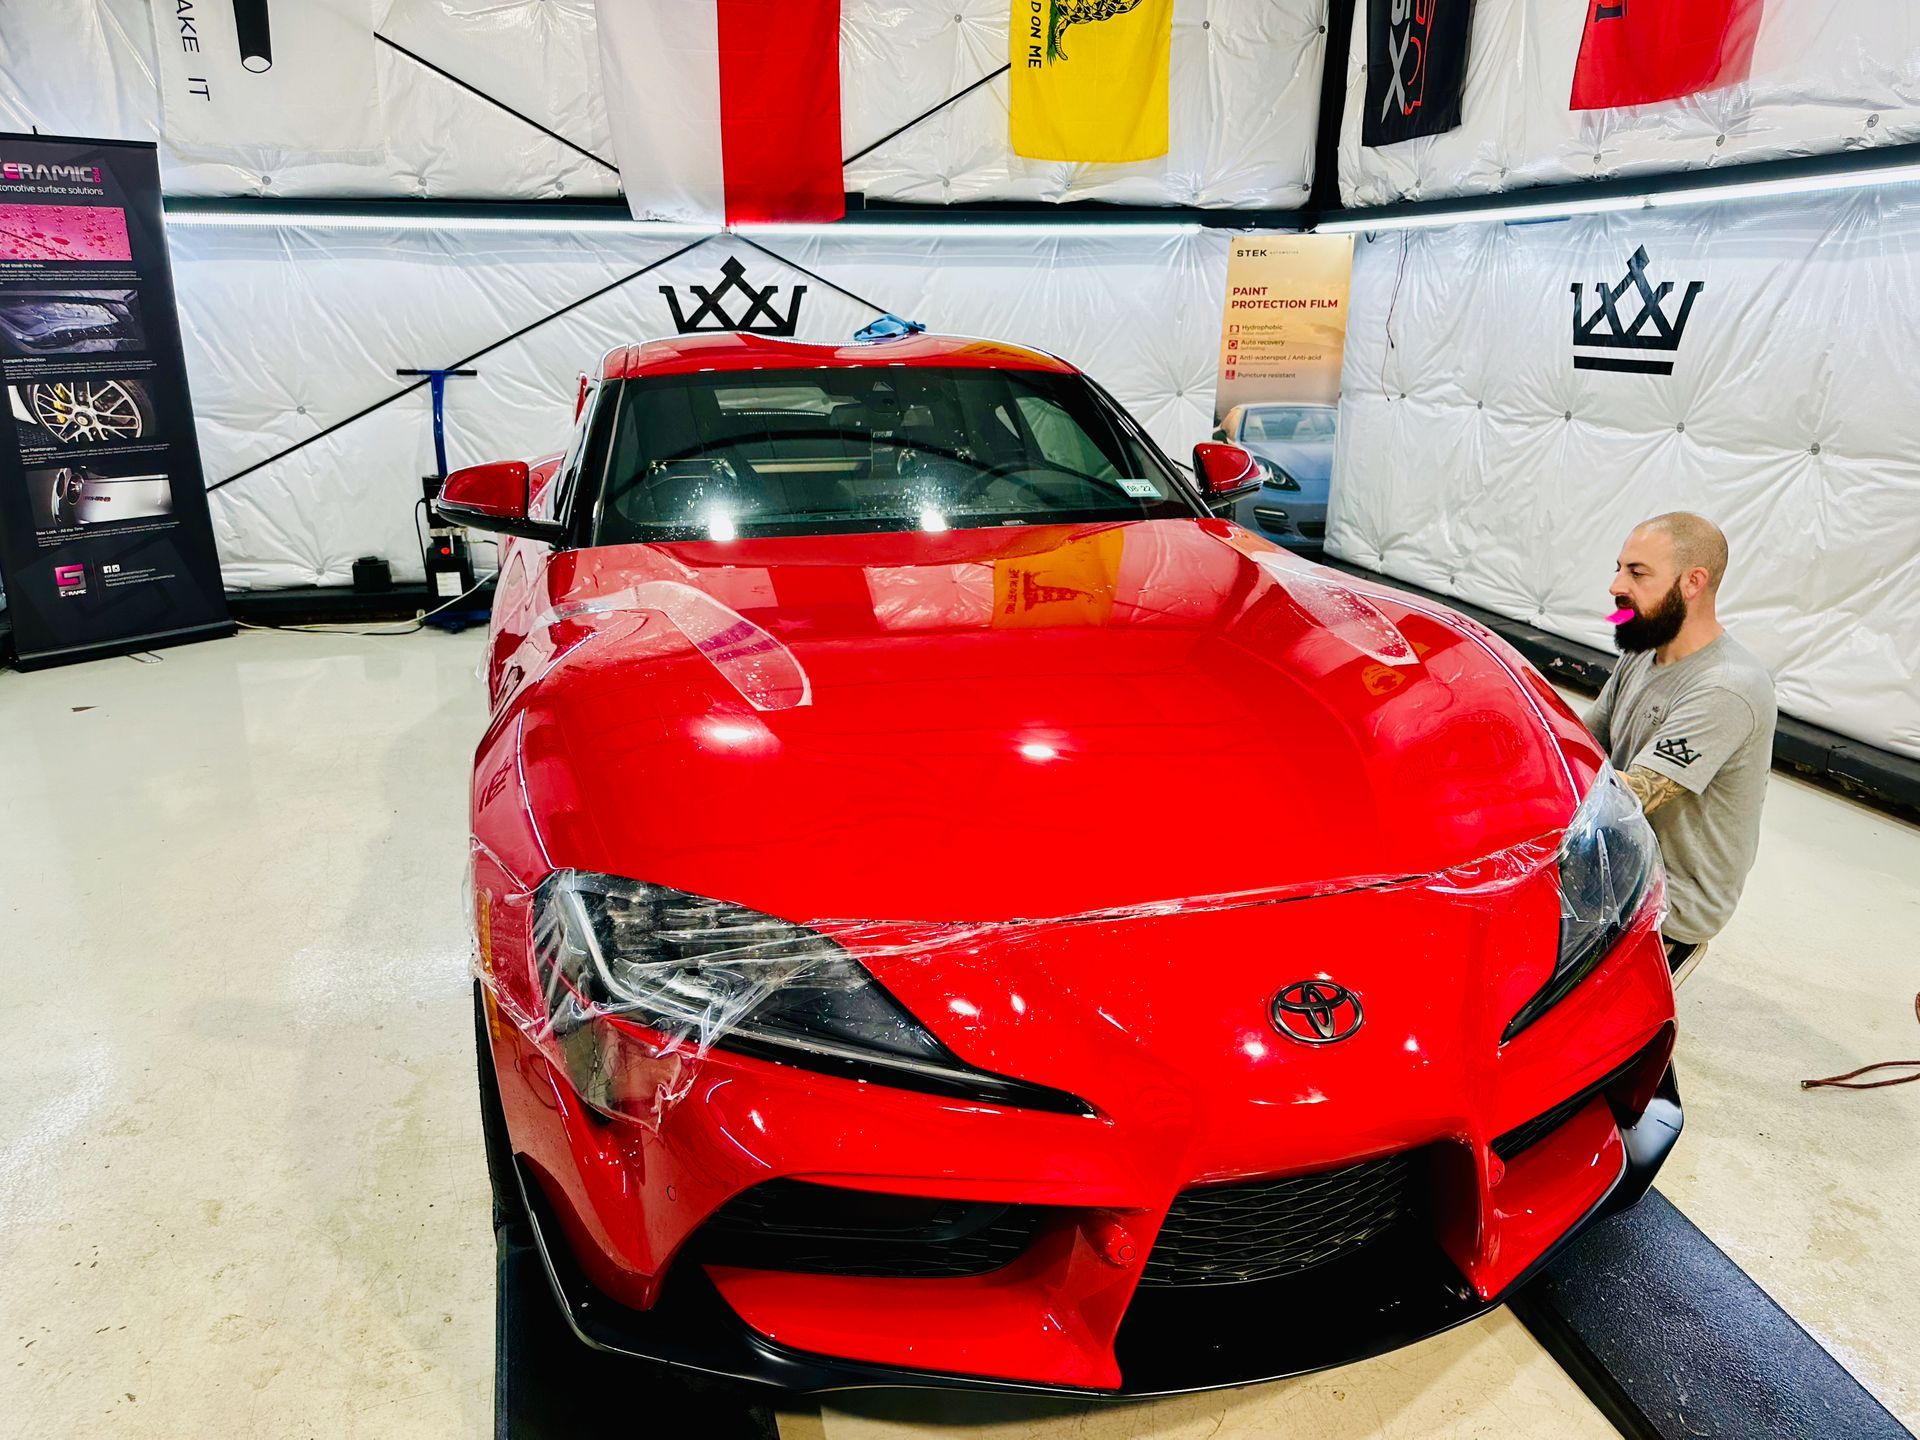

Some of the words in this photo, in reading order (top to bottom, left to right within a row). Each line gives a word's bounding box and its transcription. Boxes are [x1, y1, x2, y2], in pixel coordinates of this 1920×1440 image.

[1030, 16, 1042, 39] ON
[1028, 45, 1042, 69] ME
[188, 77, 210, 101] IT
[0, 158, 93, 183] ERAMIC
[37, 185, 67, 195] surface
[68, 186, 104, 196] solutions
[1237, 249, 1267, 257] STEK
[1232, 286, 1269, 296] PAINT
[1231, 299, 1307, 309] PROTECTION
[1310, 299, 1338, 308] FILM
[1242, 324, 1283, 332] Hydrophobic
[1239, 354, 1287, 363] Anti-waterspot
[1237, 371, 1267, 379] Puncture
